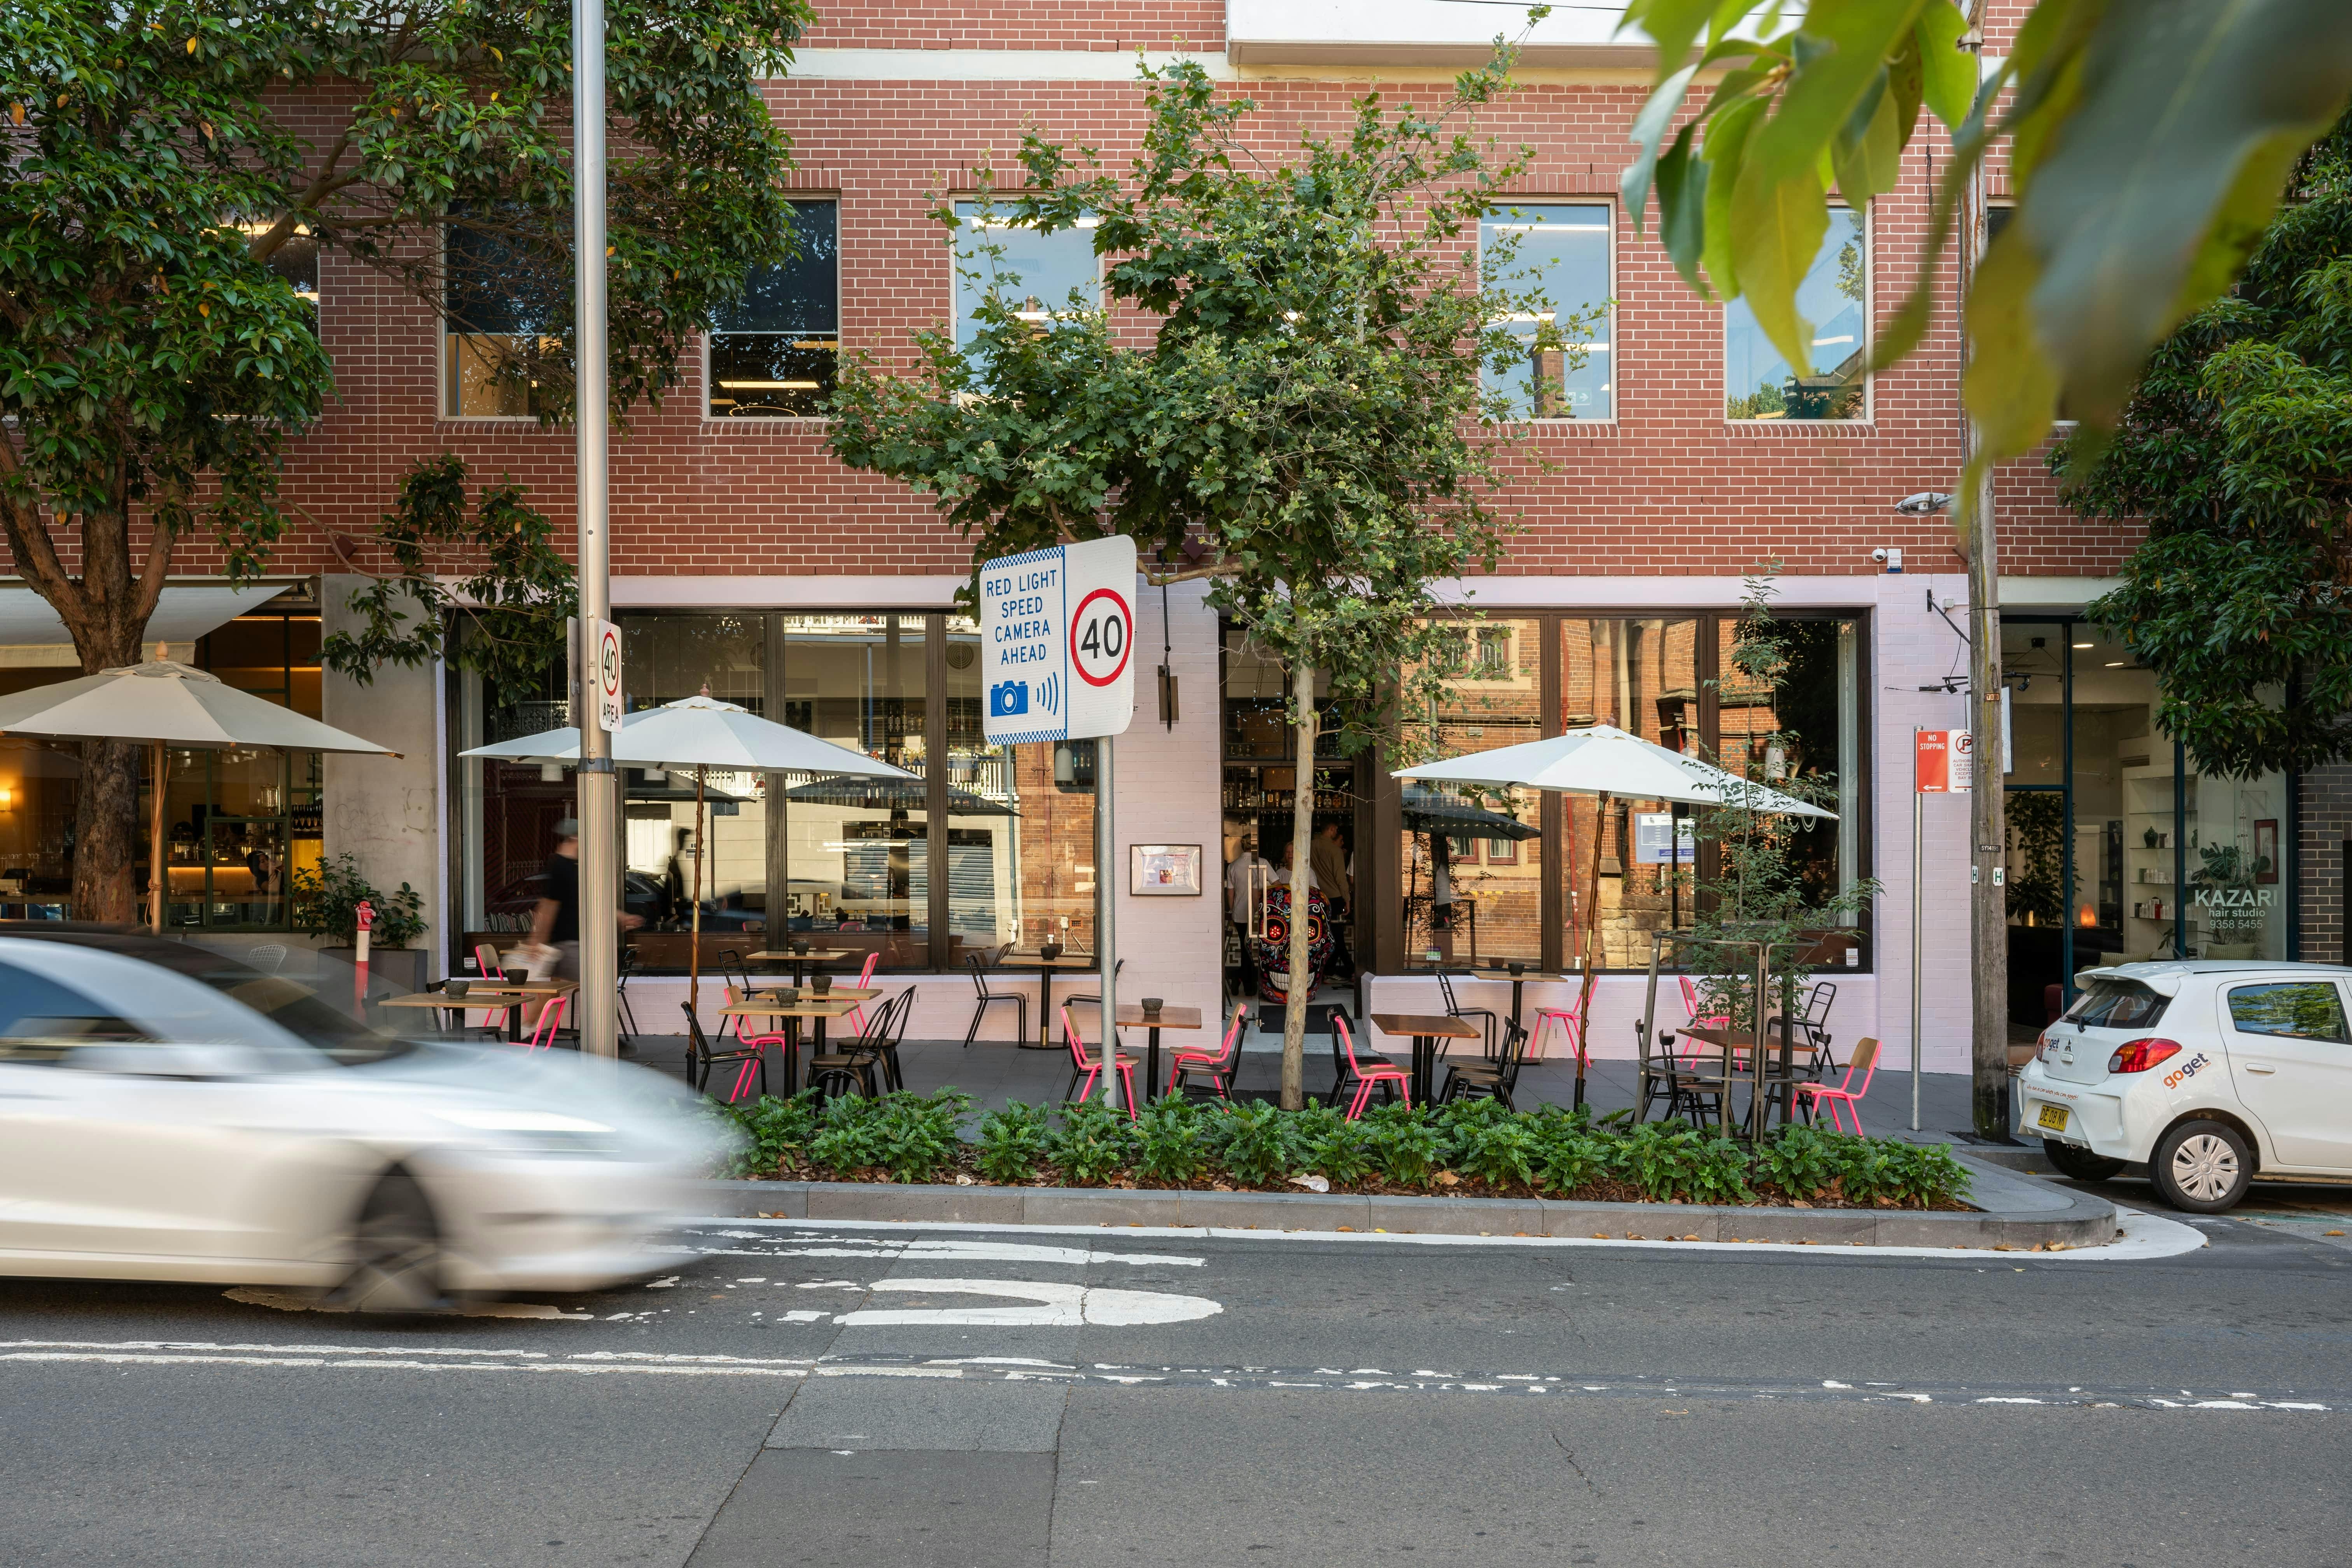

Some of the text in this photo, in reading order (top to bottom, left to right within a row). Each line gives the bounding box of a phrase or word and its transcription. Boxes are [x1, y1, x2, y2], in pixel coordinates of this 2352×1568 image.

[987, 569, 1057, 597] RED LIGHT
[1001, 596, 1043, 618] SPEED
[995, 619, 1051, 643] CAMERA
[1081, 614, 1123, 659] 40
[604, 648, 616, 680] 40
[1000, 644, 1046, 665] AHEAD
[603, 702, 620, 724] AREA
[1972, 869, 1977, 881] H
[1995, 872, 2002, 882] H
[2195, 889, 2278, 906] KAZARI
[2208, 908, 2265, 917] hair studio
[2210, 920, 2263, 929] 9358 5455
[2043, 1038, 2059, 1051] goget
[2163, 1053, 2208, 1089] goget
[2195, 1061, 2211, 1074] .com.au
[2040, 1108, 2049, 1122] DE
[2049, 1110, 2058, 1124] 08
[2057, 1111, 2067, 1127] NK
